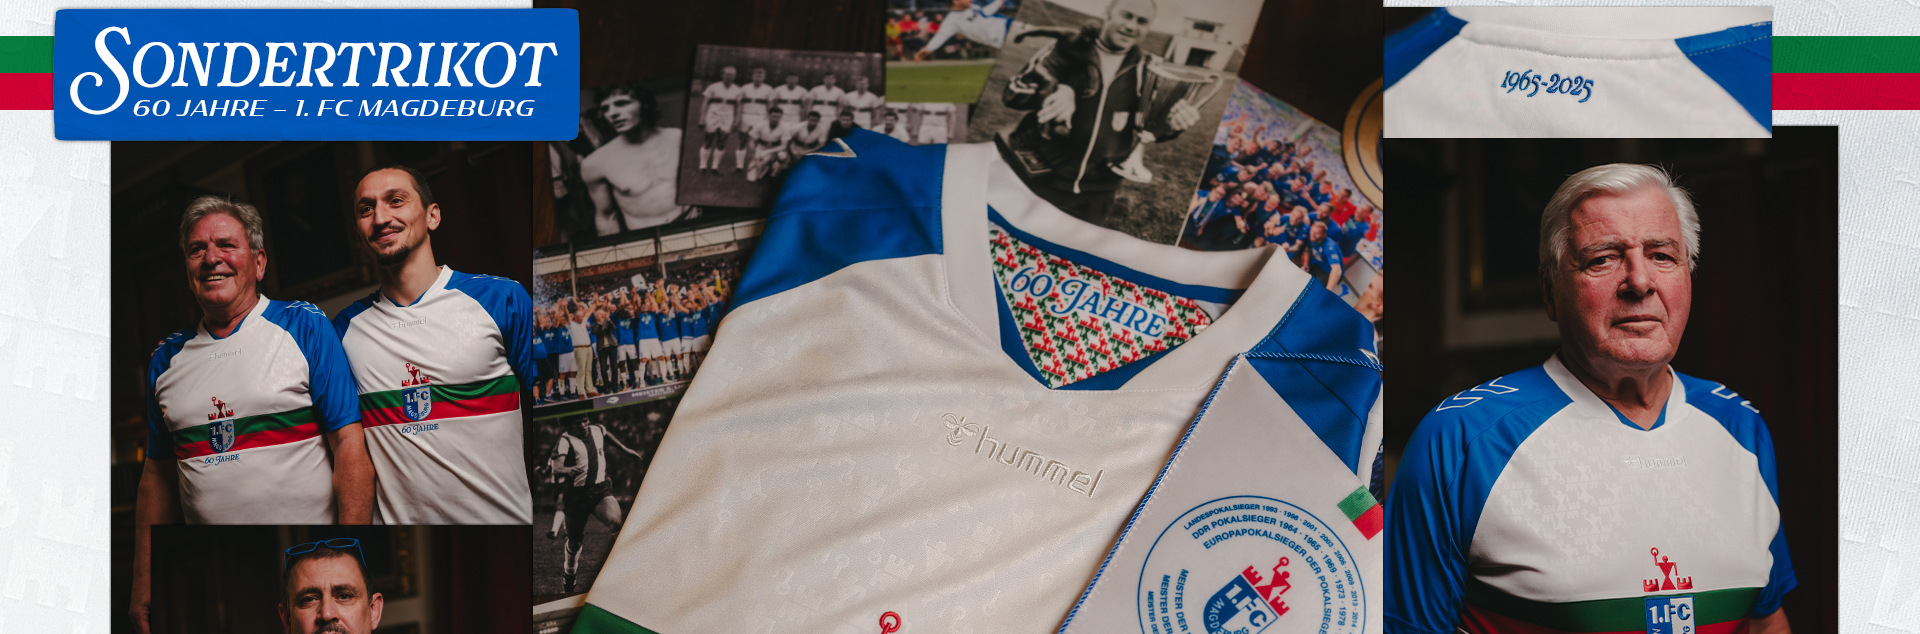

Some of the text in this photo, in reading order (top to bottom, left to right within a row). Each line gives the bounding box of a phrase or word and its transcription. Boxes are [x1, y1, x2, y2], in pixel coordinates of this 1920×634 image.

[1500, 69, 1594, 103] 1965-2025
[1010, 267, 1166, 338] 60 JAHRE
[401, 423, 440, 436] 60 JAHRE
[205, 453, 241, 467] 60 JAHRE
[974, 425, 1106, 499] hummel
[1183, 503, 1261, 531] LANDESPOKALSIEGER
[1262, 504, 1279, 514] 1993
[1283, 510, 1300, 521] 1998
[1302, 519, 1318, 532] 2001
[1203, 528, 1307, 558] EUROPAPOKALSIEGER
[1305, 555, 1322, 575] DER
[1319, 532, 1335, 548] 2003
[1191, 514, 1347, 627] DDR POKALSIEGER 1964 1965 1969 1973 1978
[1147, 590, 1156, 623] MEISTER
[1159, 574, 1172, 614] MEISTER
[1174, 568, 1190, 632] MEISTER DER
[1350, 590, 1359, 607] 2013
[1350, 611, 1359, 628] 2014
